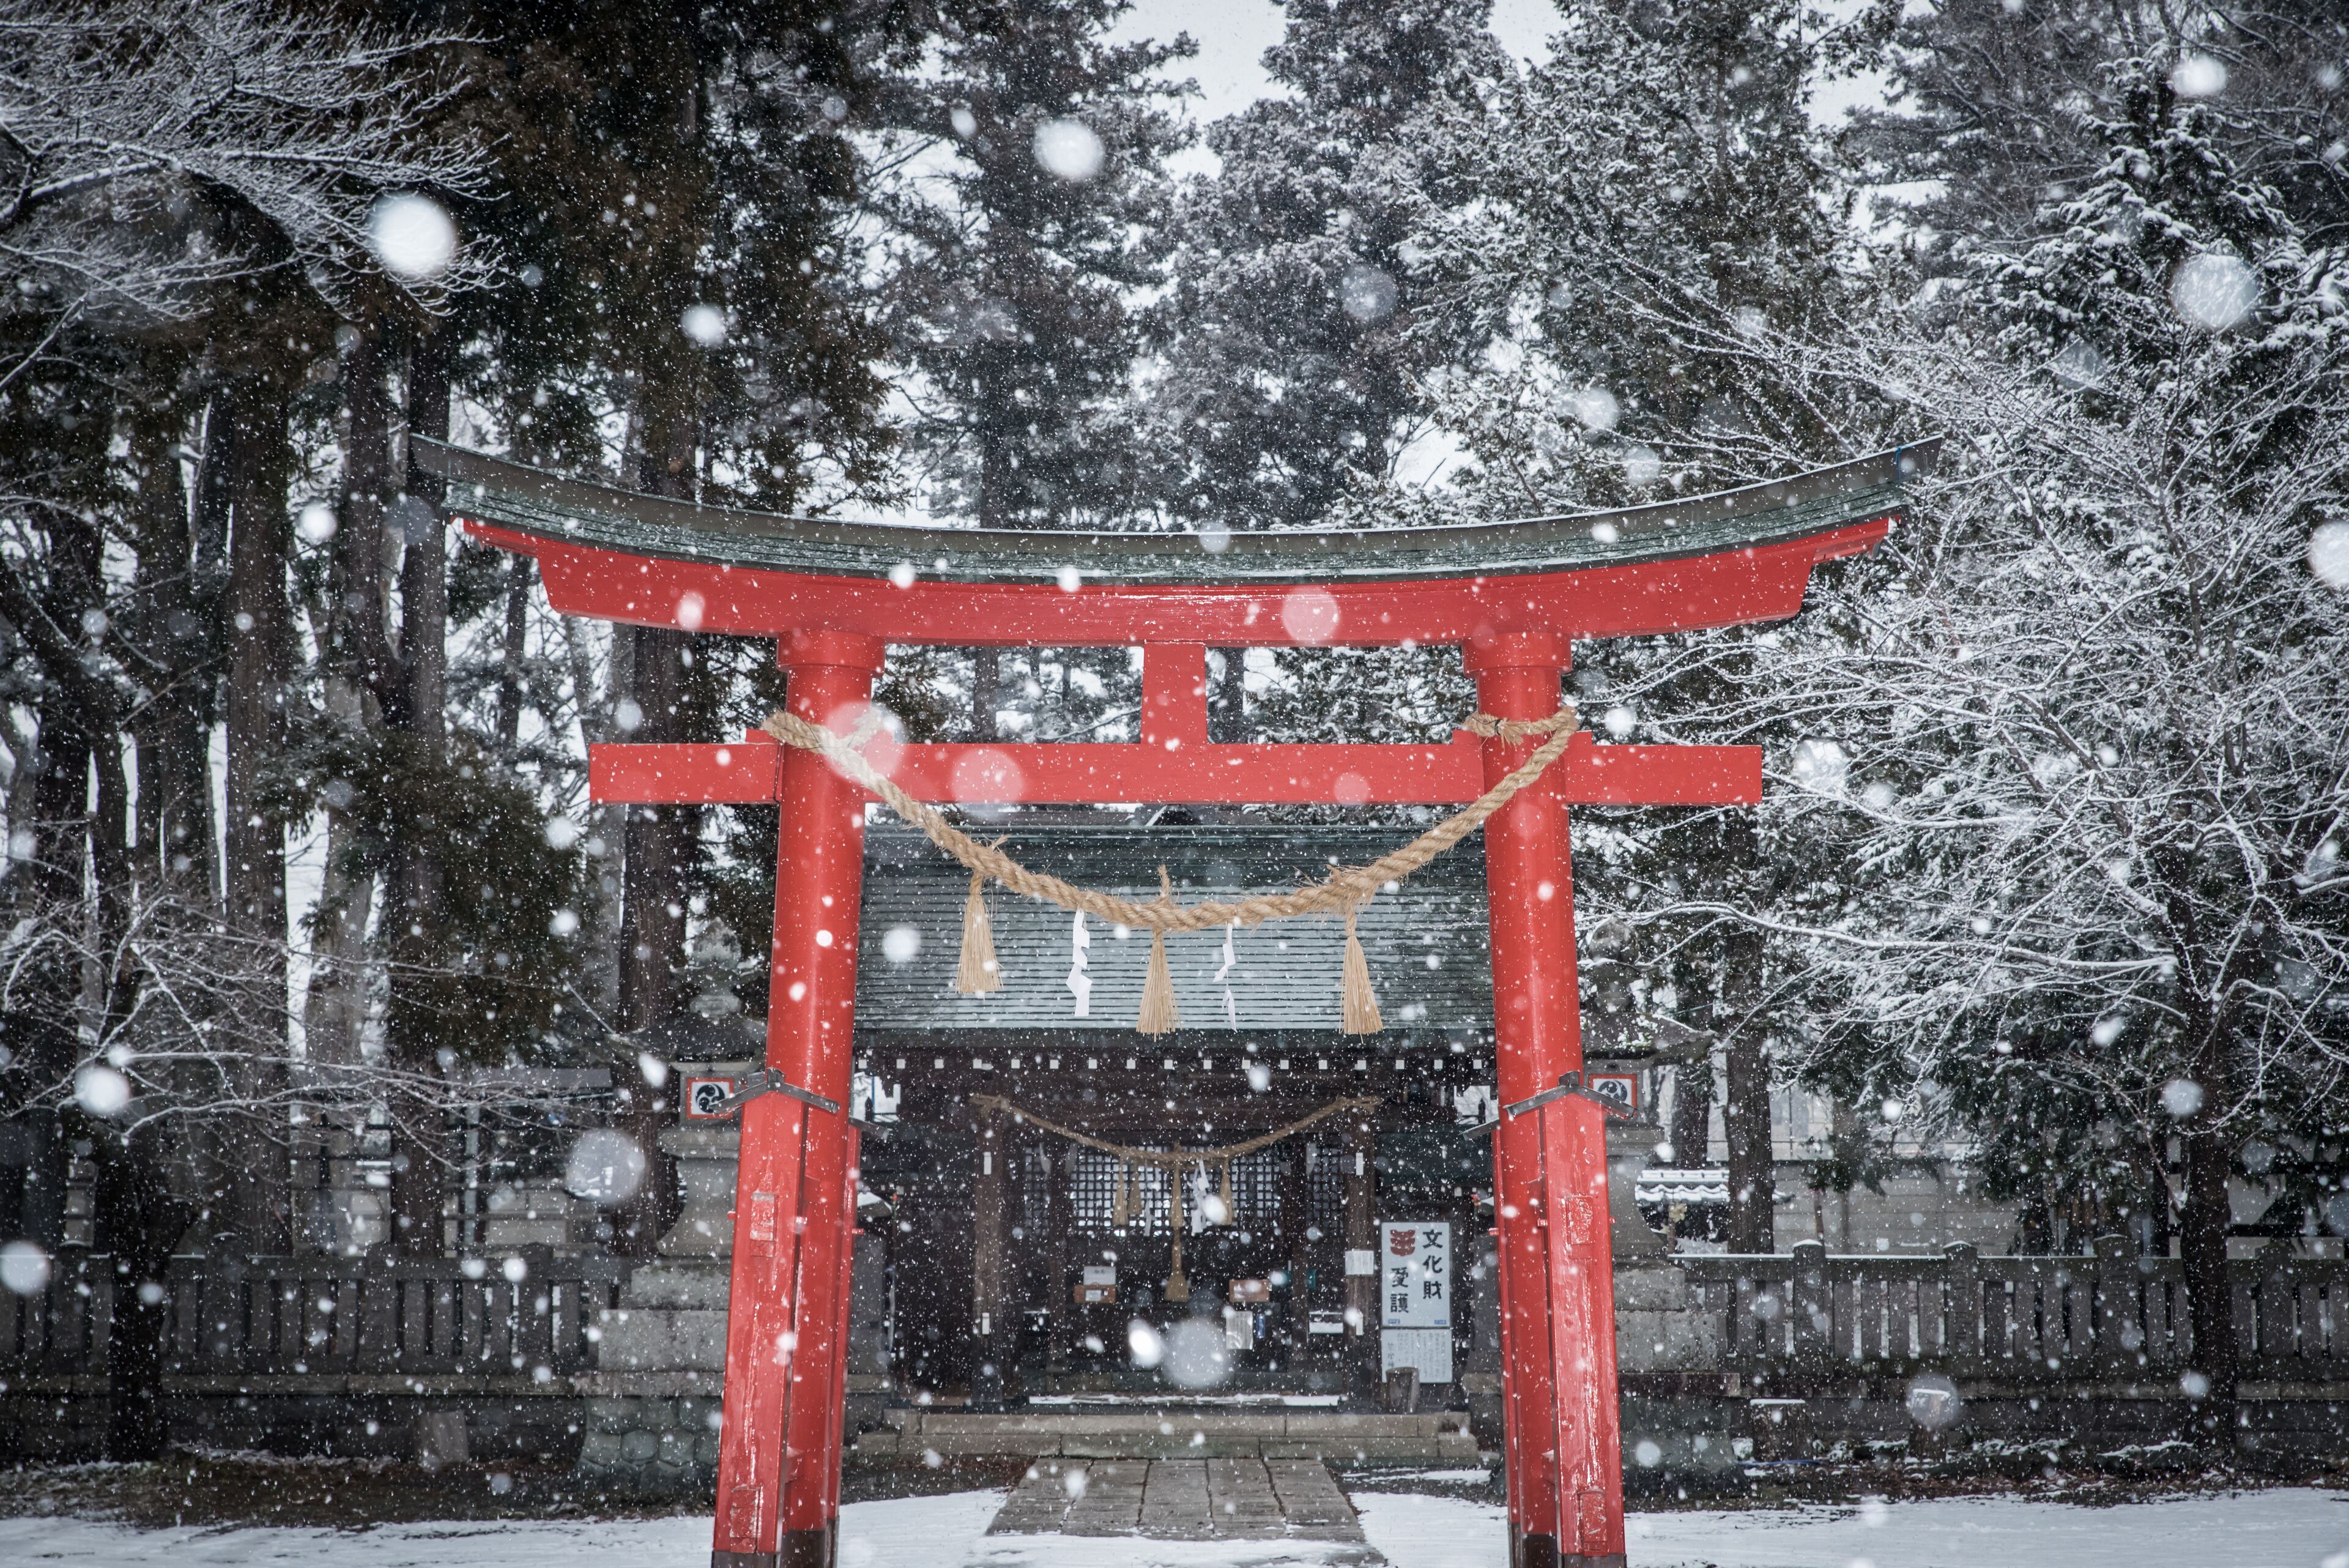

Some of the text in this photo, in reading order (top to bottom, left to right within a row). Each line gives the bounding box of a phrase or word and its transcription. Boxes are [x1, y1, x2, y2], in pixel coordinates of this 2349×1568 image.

[1390, 1267, 1409, 1313] 愛護
[1422, 1229, 1443, 1299] 文化財
